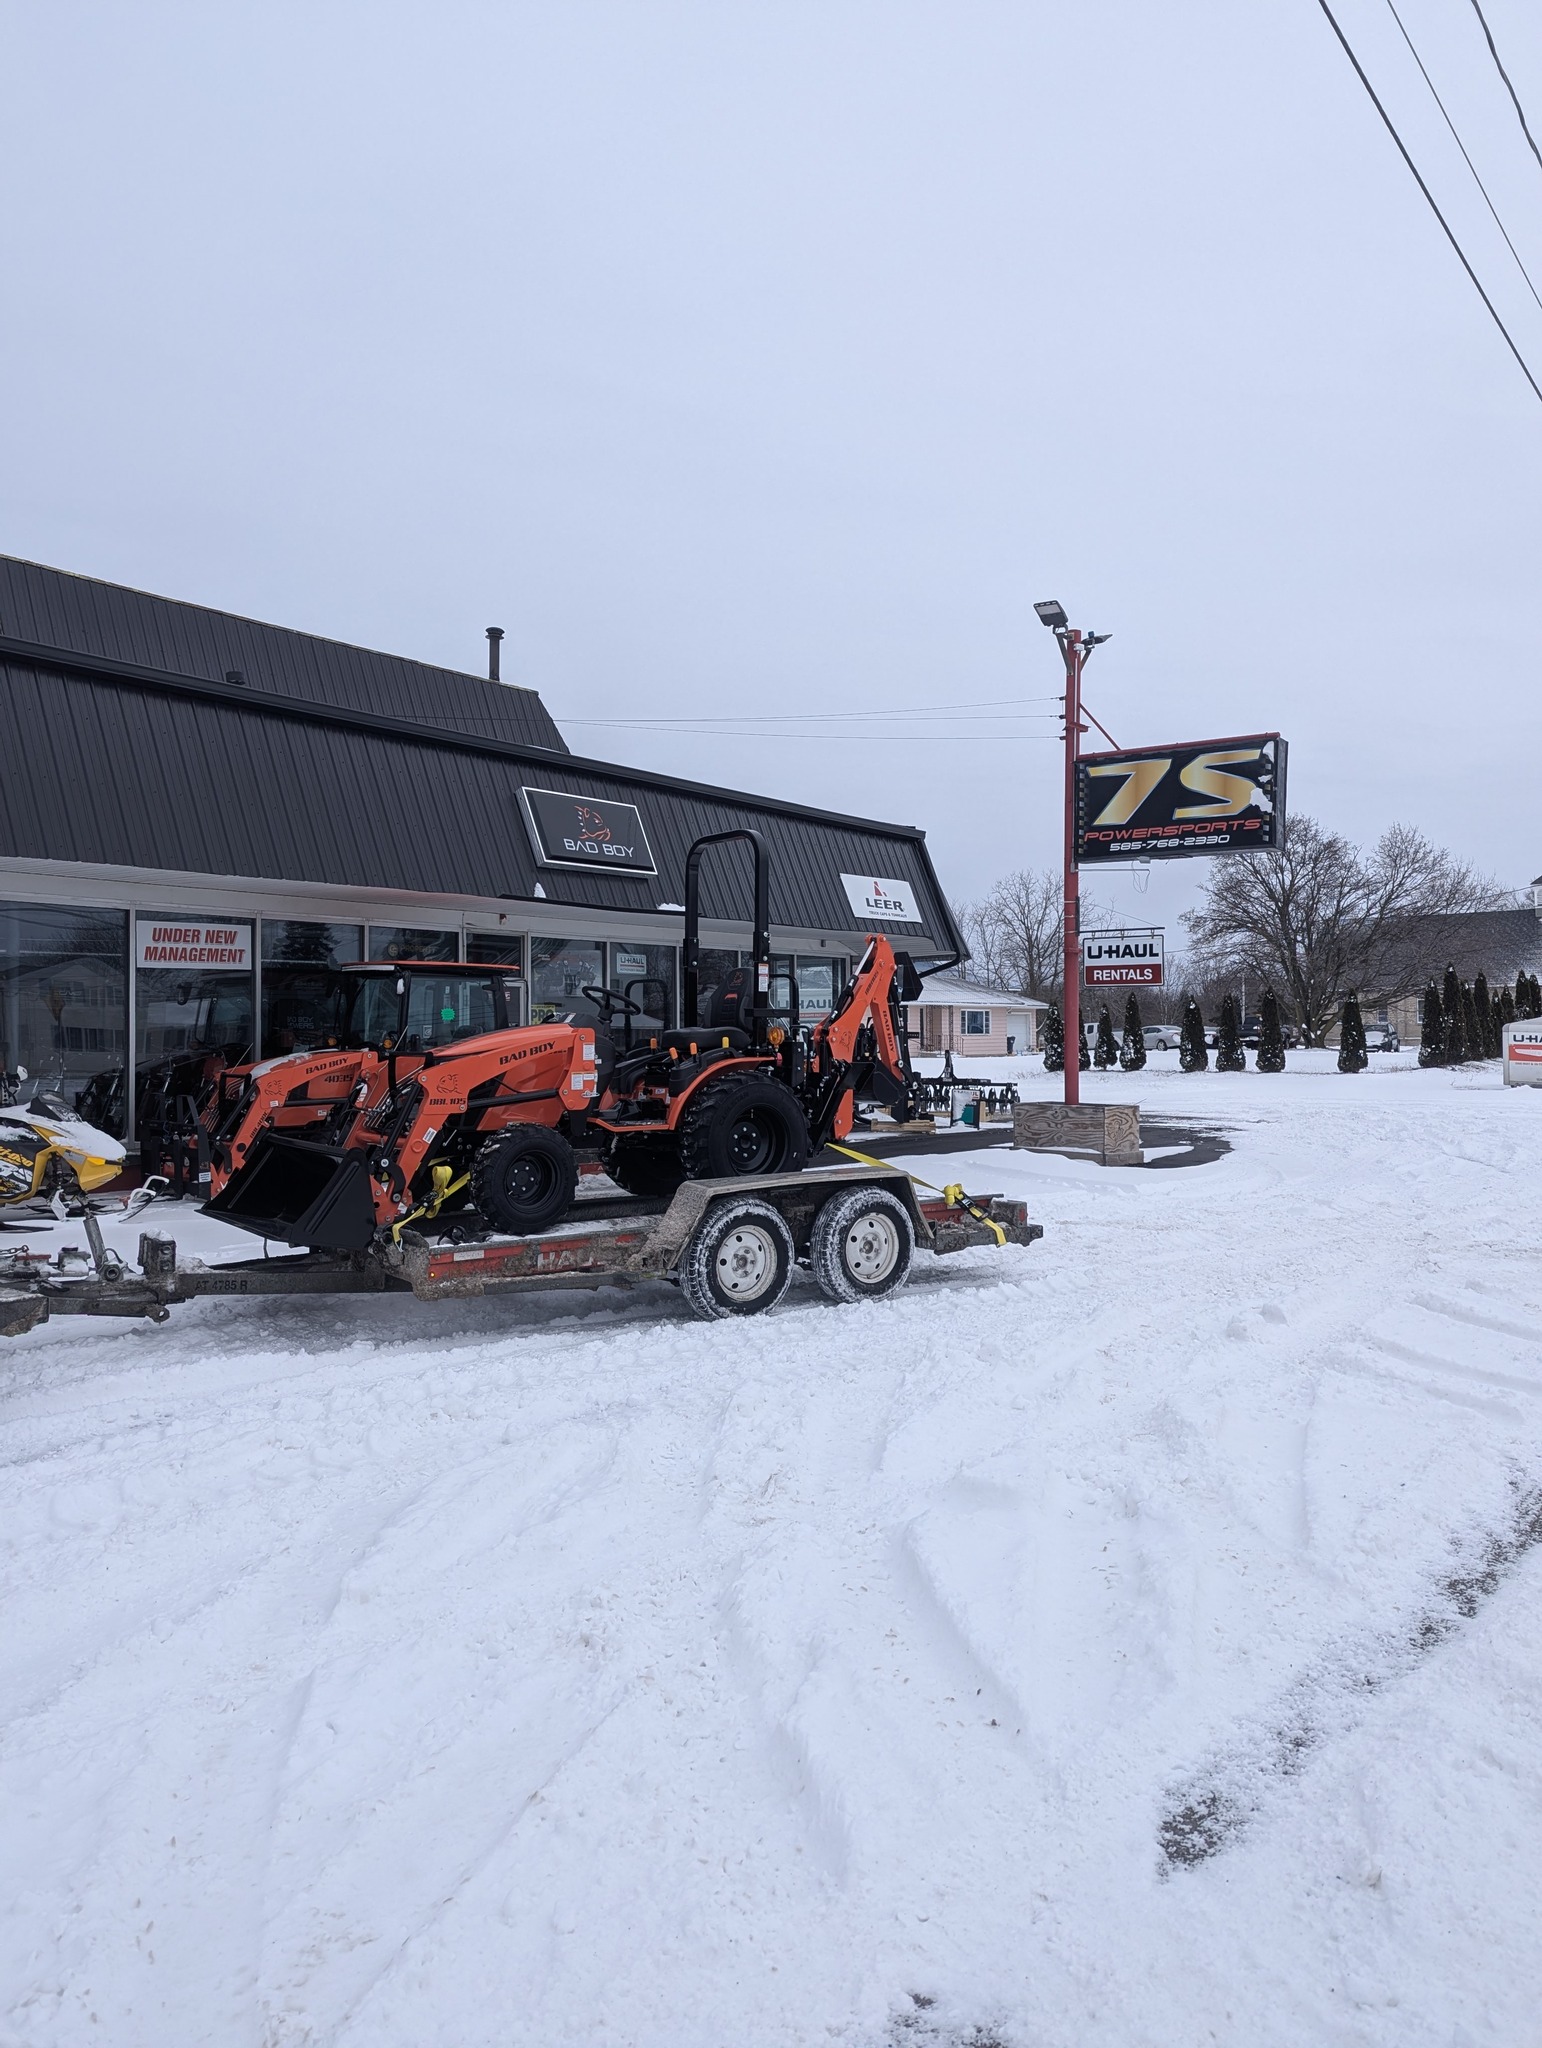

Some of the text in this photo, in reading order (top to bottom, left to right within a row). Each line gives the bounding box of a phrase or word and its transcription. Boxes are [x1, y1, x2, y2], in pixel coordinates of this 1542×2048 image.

[1086, 749, 1262, 826] 7S
[1084, 819, 1262, 842] POWERSPORTS
[563, 838, 634, 857] BAD BOY
[1110, 835, 1231, 852] 585-768-2330
[865, 897, 905, 912] LEER
[151, 927, 238, 946] UNDER NEW
[143, 945, 246, 964] MANAGEMENT
[1087, 943, 1160, 959] U-HAUL
[620, 956, 644, 965] U-HAUL
[1093, 968, 1153, 981] RENTALS
[777, 999, 833, 1010] UHAUL
[1513, 1034, 1542, 1043] U-H
[499, 1040, 556, 1065] BAD BOY
[305, 1057, 349, 1075] BAD BOY
[212, 1280, 237, 1291] 4785
[240, 1280, 248, 1291] R
